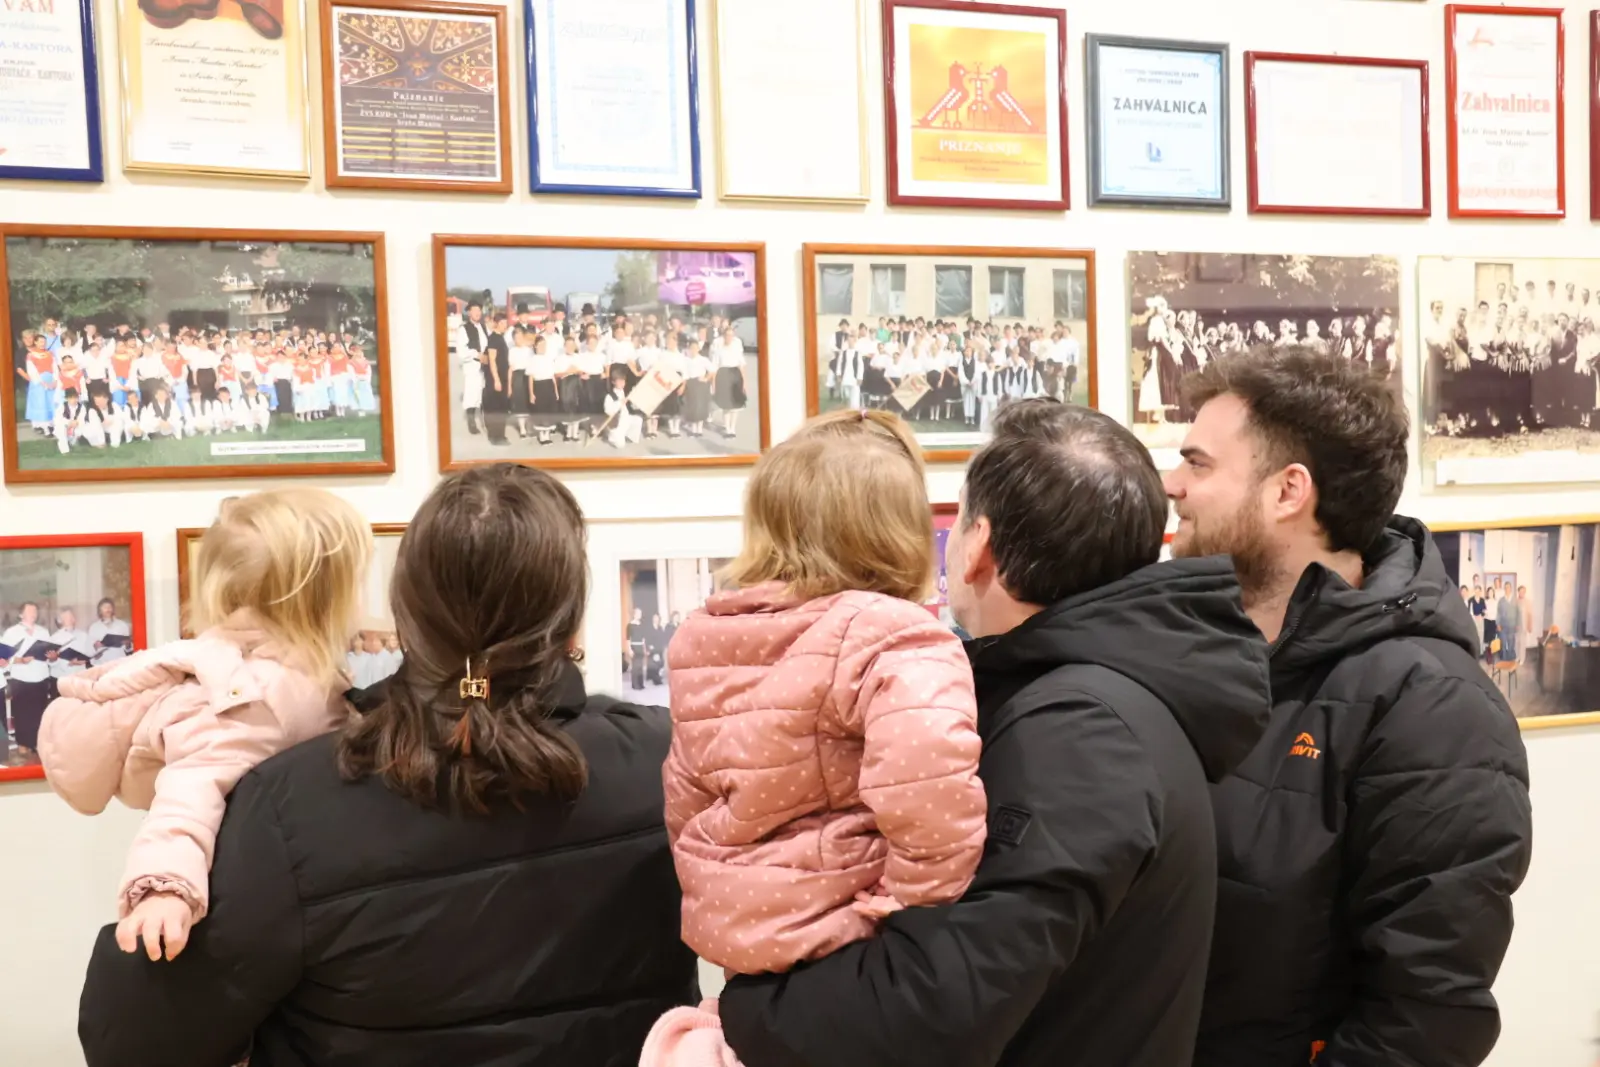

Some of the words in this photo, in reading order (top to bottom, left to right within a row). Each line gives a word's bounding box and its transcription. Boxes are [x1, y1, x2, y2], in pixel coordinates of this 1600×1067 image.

[1112, 96, 1208, 115] ZAHVALNICA
[1461, 91, 1551, 113] Zahvalnica
[939, 139, 1022, 156] PRIZNANJE
